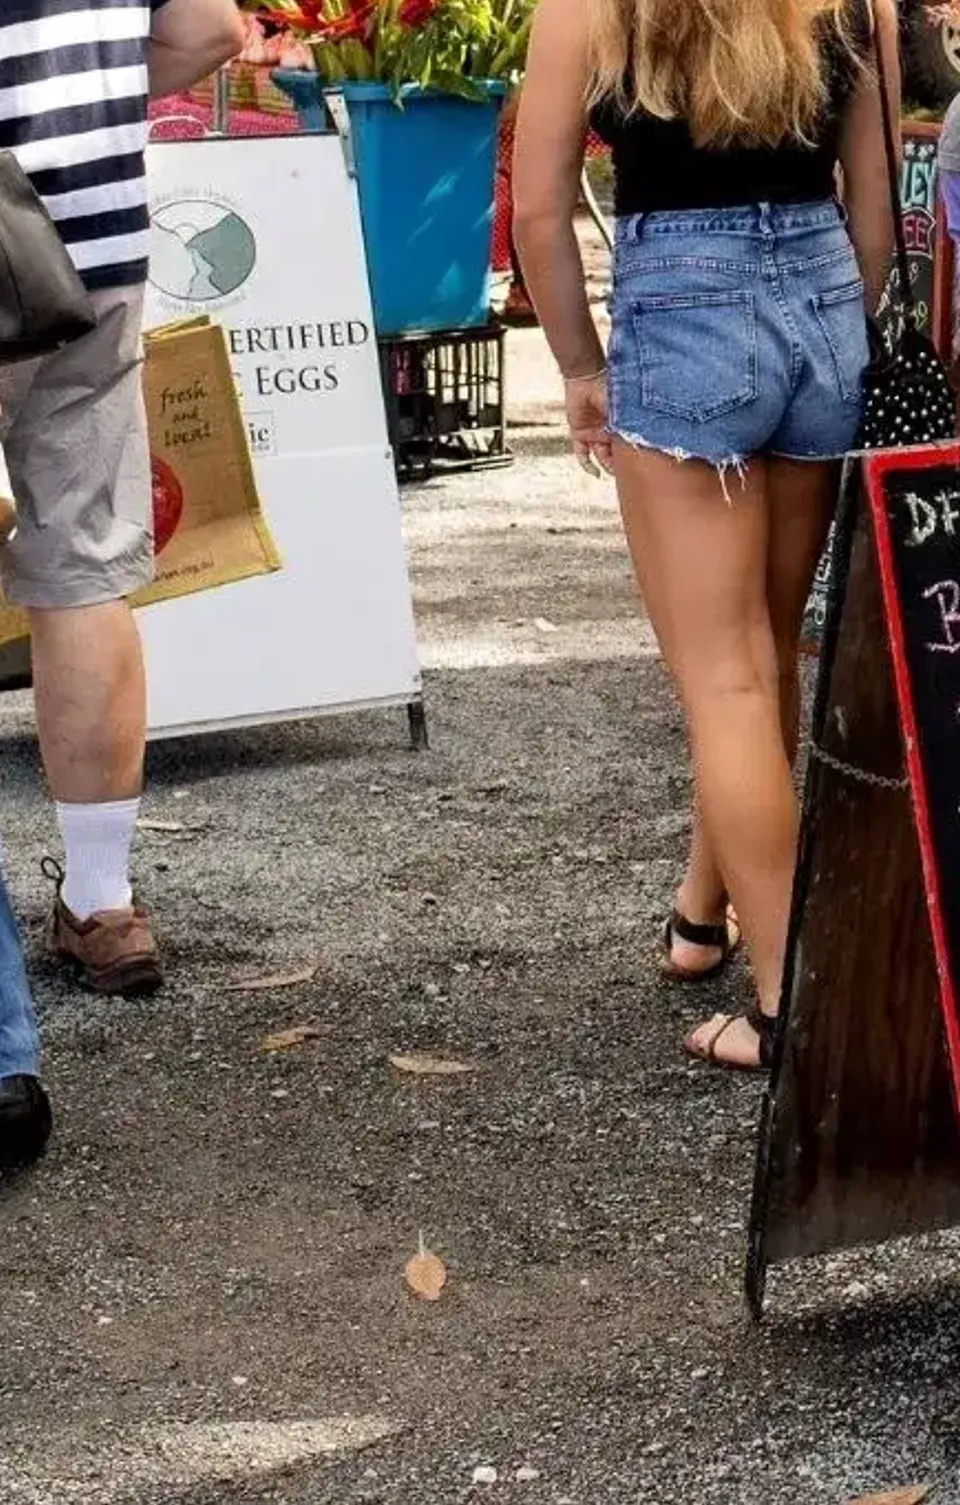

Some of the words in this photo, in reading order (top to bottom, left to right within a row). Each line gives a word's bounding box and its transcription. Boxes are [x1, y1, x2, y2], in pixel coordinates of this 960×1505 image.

[255, 364, 339, 395] EGGS
[160, 380, 207, 417] fresh
[172, 405, 201, 424] and
[164, 422, 211, 447] local
